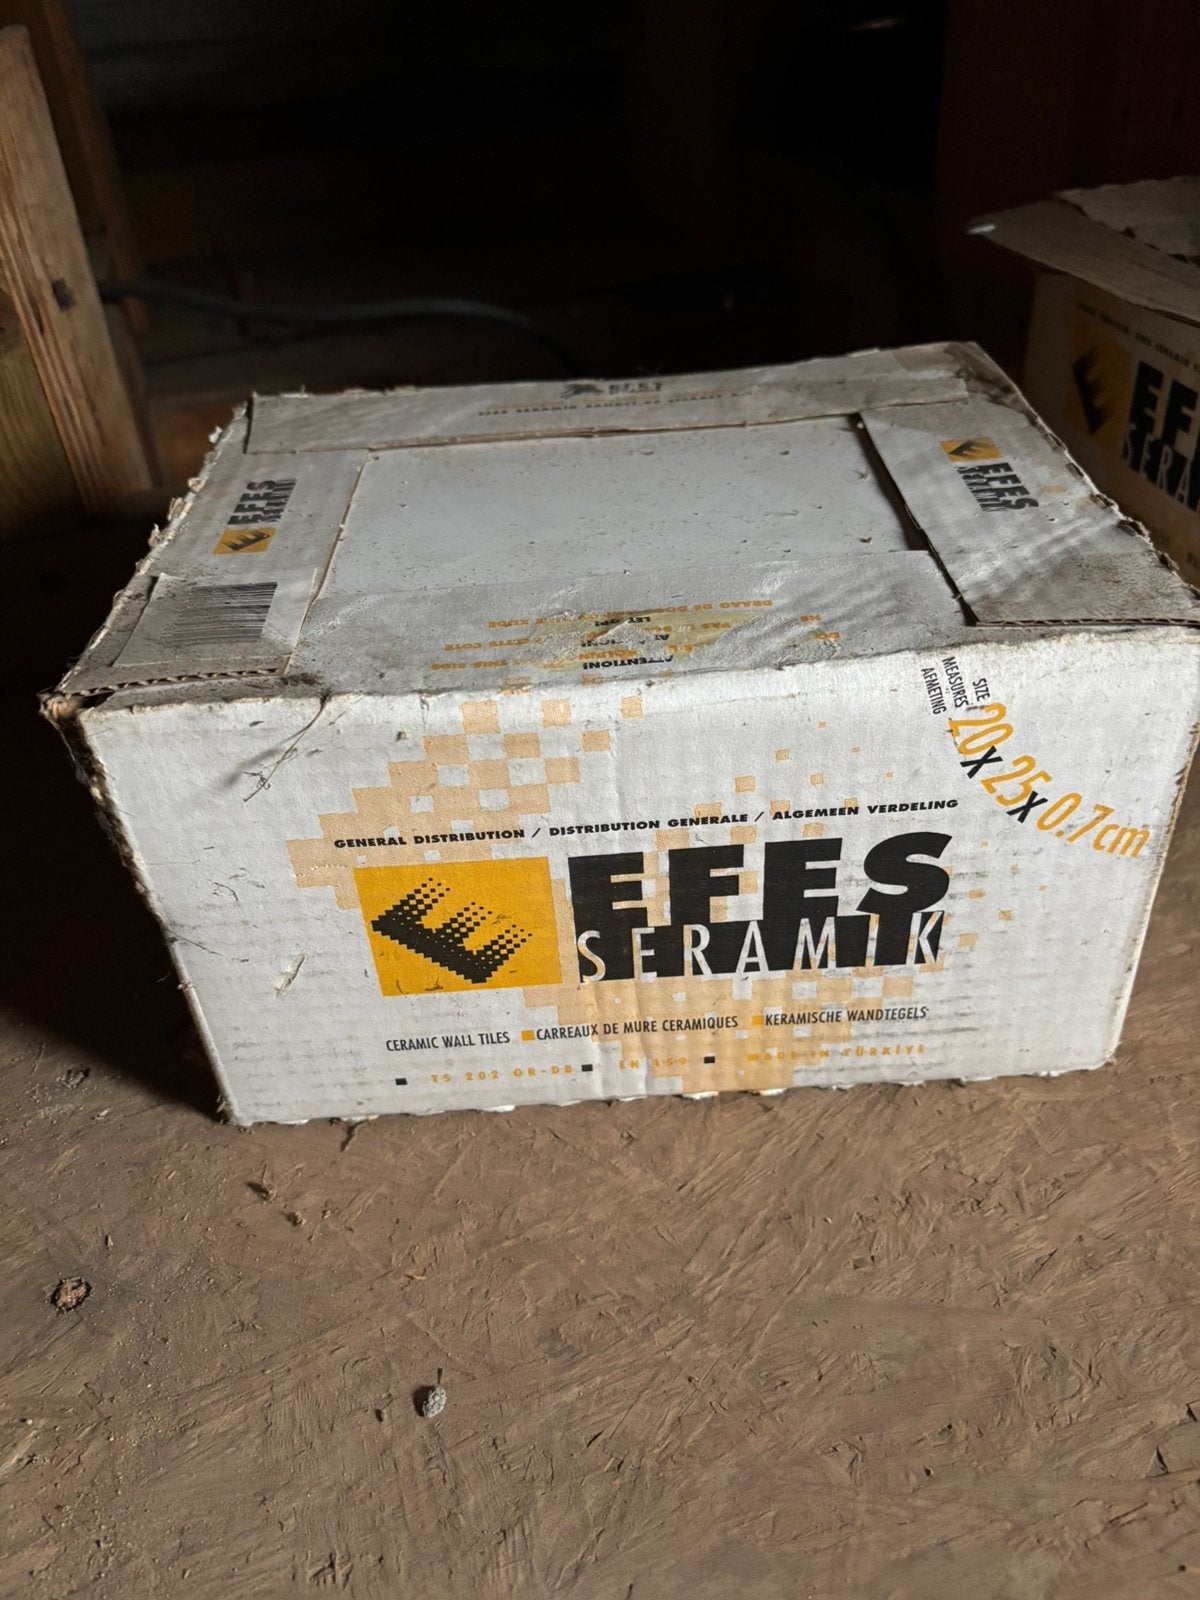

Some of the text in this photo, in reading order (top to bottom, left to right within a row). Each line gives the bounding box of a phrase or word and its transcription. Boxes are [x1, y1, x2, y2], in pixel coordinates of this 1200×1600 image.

[921, 667, 947, 715] AFMETING
[942, 656, 969, 708] MEASURES
[972, 678, 991, 701] SIZE
[334, 836, 407, 848] GENERAL
[414, 829, 525, 844] DISTRIBUTION
[549, 820, 660, 836] DISTRIBUTION
[667, 813, 749, 828] GENERALE
[772, 806, 859, 820] ALGEMEEN
[867, 799, 958, 814] VERDELING
[568, 831, 952, 928] EFES
[576, 910, 945, 984] SERAMIK
[536, 1015, 738, 1041] CARREAUX DE MURE CERAMIQUES
[765, 1006, 927, 1026] KERAMISCHE WANDTEGELS
[386, 1031, 510, 1051] CERAMIC WALL TILES
[465, 1070, 499, 1081] 202
[618, 1058, 640, 1070] EN
